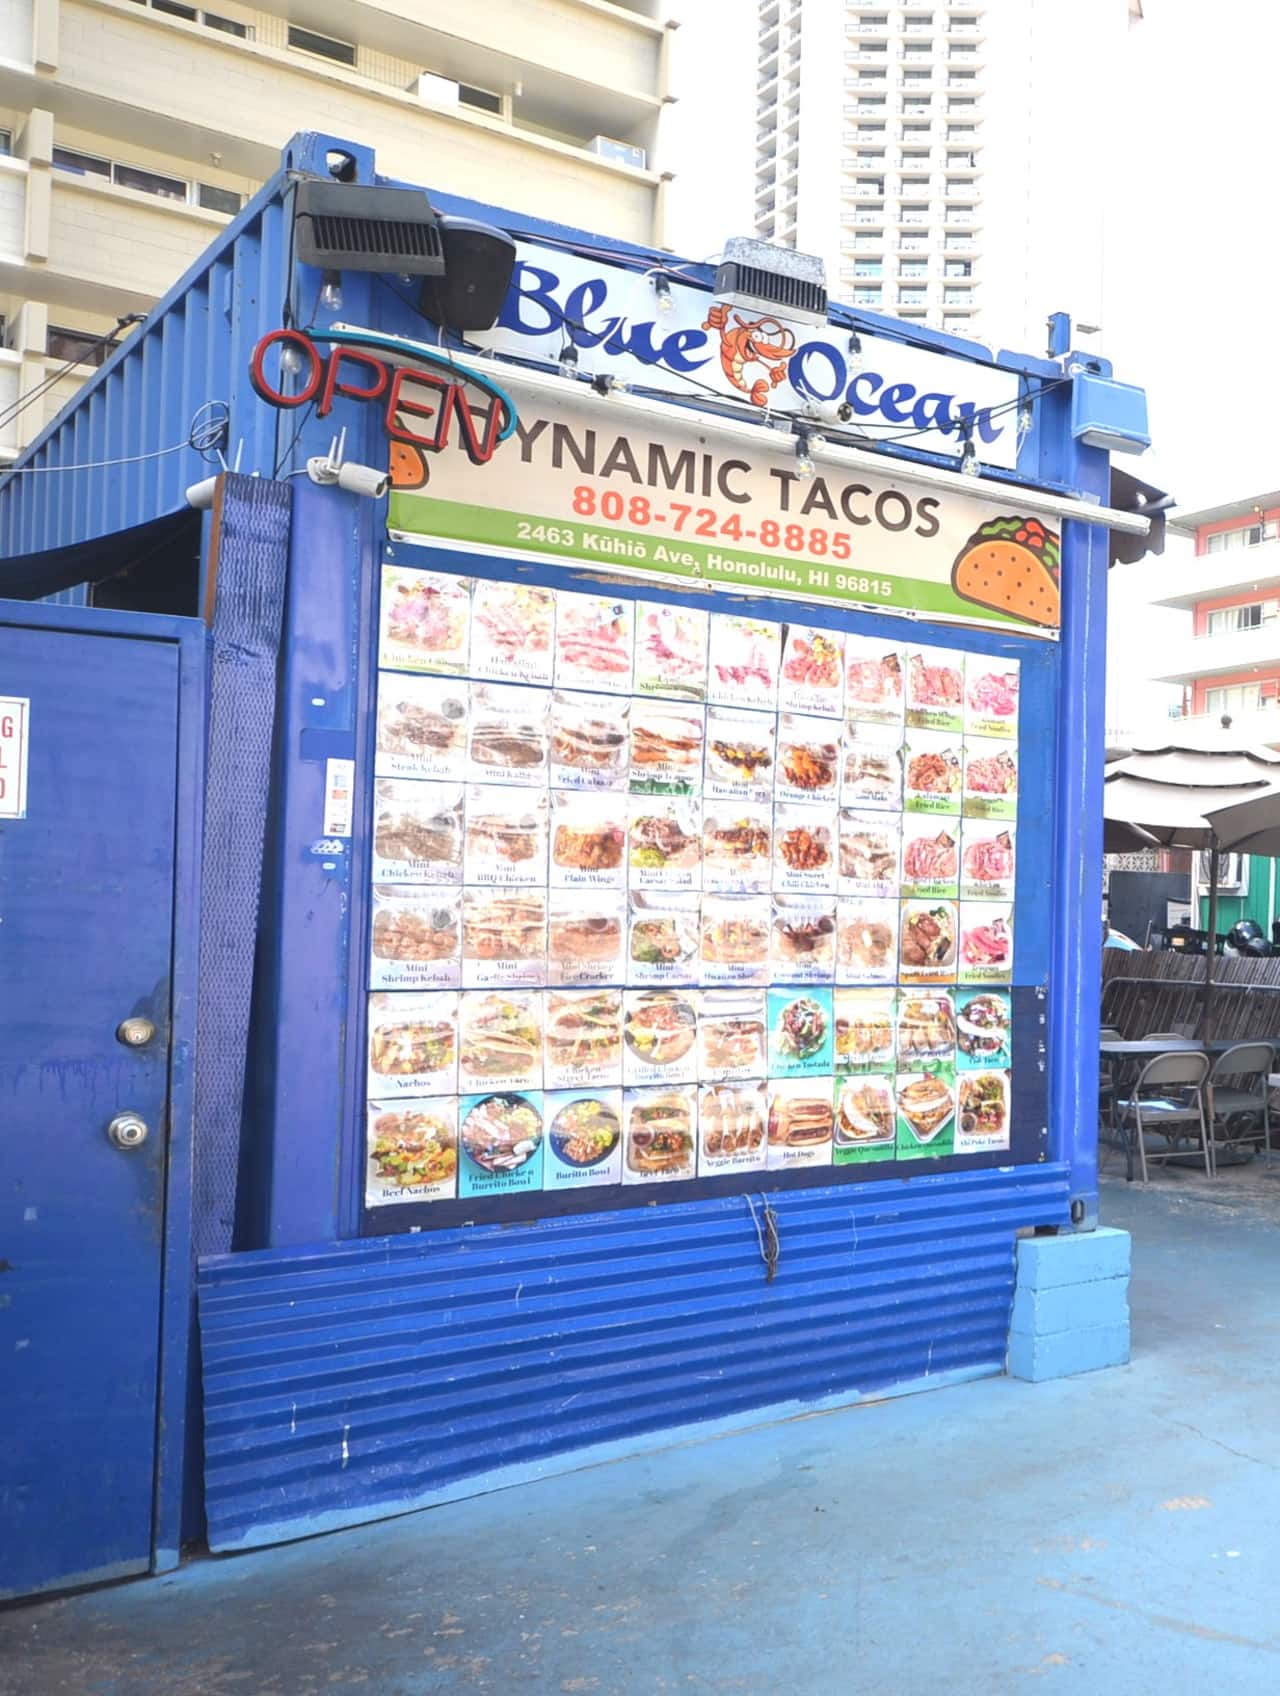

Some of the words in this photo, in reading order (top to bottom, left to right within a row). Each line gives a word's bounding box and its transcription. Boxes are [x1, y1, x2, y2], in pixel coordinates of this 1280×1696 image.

[495, 260, 714, 372] Blue
[788, 341, 1004, 444] Ocean
[250, 328, 506, 465] OPEN
[769, 468, 940, 538] TACOS
[572, 486, 851, 560] 808-724-8885
[517, 522, 575, 547] 2463
[707, 553, 802, 586] Honolulu,
[808, 569, 830, 588] HI
[835, 575, 892, 597] 96815
[406, 963, 428, 972] Mini
[381, 973, 419, 984] Shrimp
[419, 972, 450, 983] Kebab
[396, 1079, 431, 1088] Nachos
[783, 1151, 797, 1159] Hot
[797, 1149, 816, 1160] Dogs
[468, 1172, 494, 1183] Fried
[495, 1168, 535, 1180] Chicken
[588, 1167, 611, 1177] Bowl
[382, 1187, 404, 1198] Beef
[405, 1184, 441, 1196] Nachos
[472, 1179, 507, 1191] Burrito
[508, 1177, 531, 1188] Bowl
